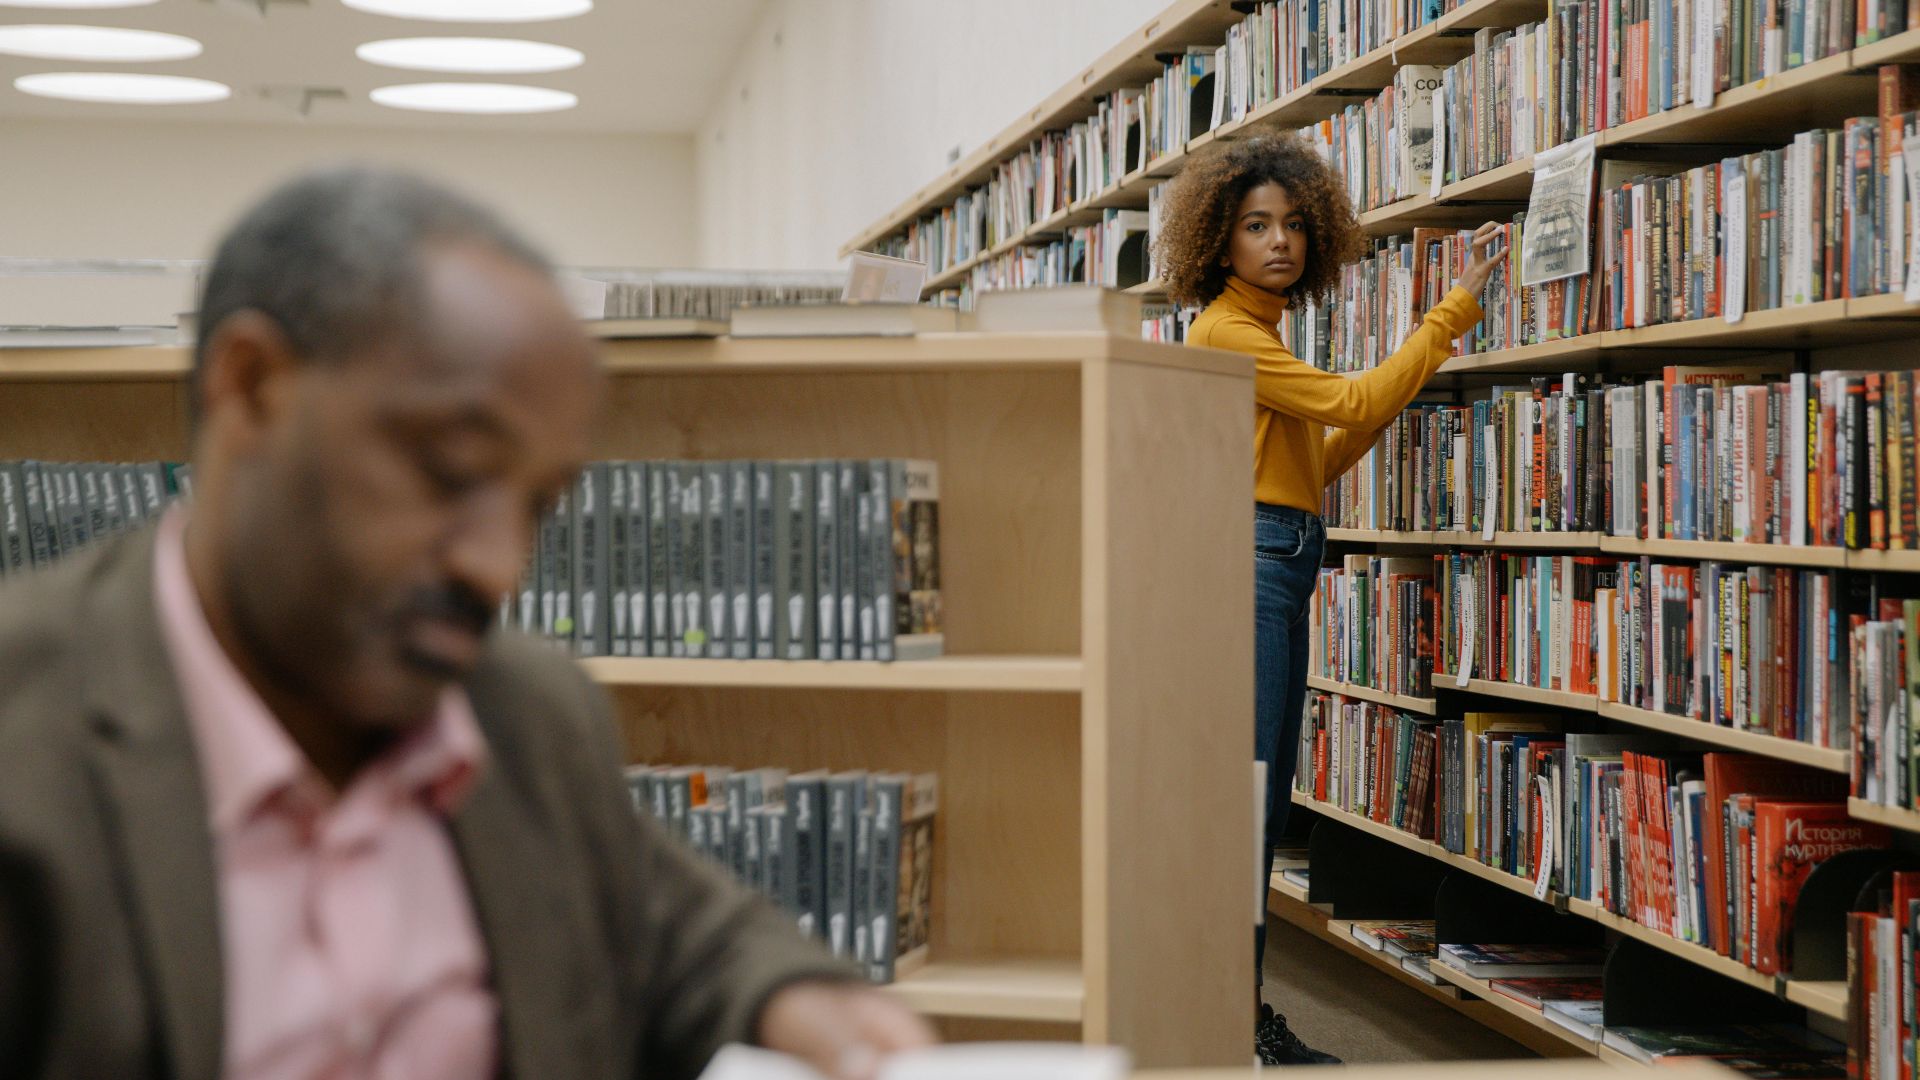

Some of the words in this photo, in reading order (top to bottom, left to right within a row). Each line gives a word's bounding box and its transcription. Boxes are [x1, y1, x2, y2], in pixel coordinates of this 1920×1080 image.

[1807, 398, 1816, 470] ПРАВДА
[1785, 818, 1862, 841] История
[1785, 843, 1884, 861] куртиза
